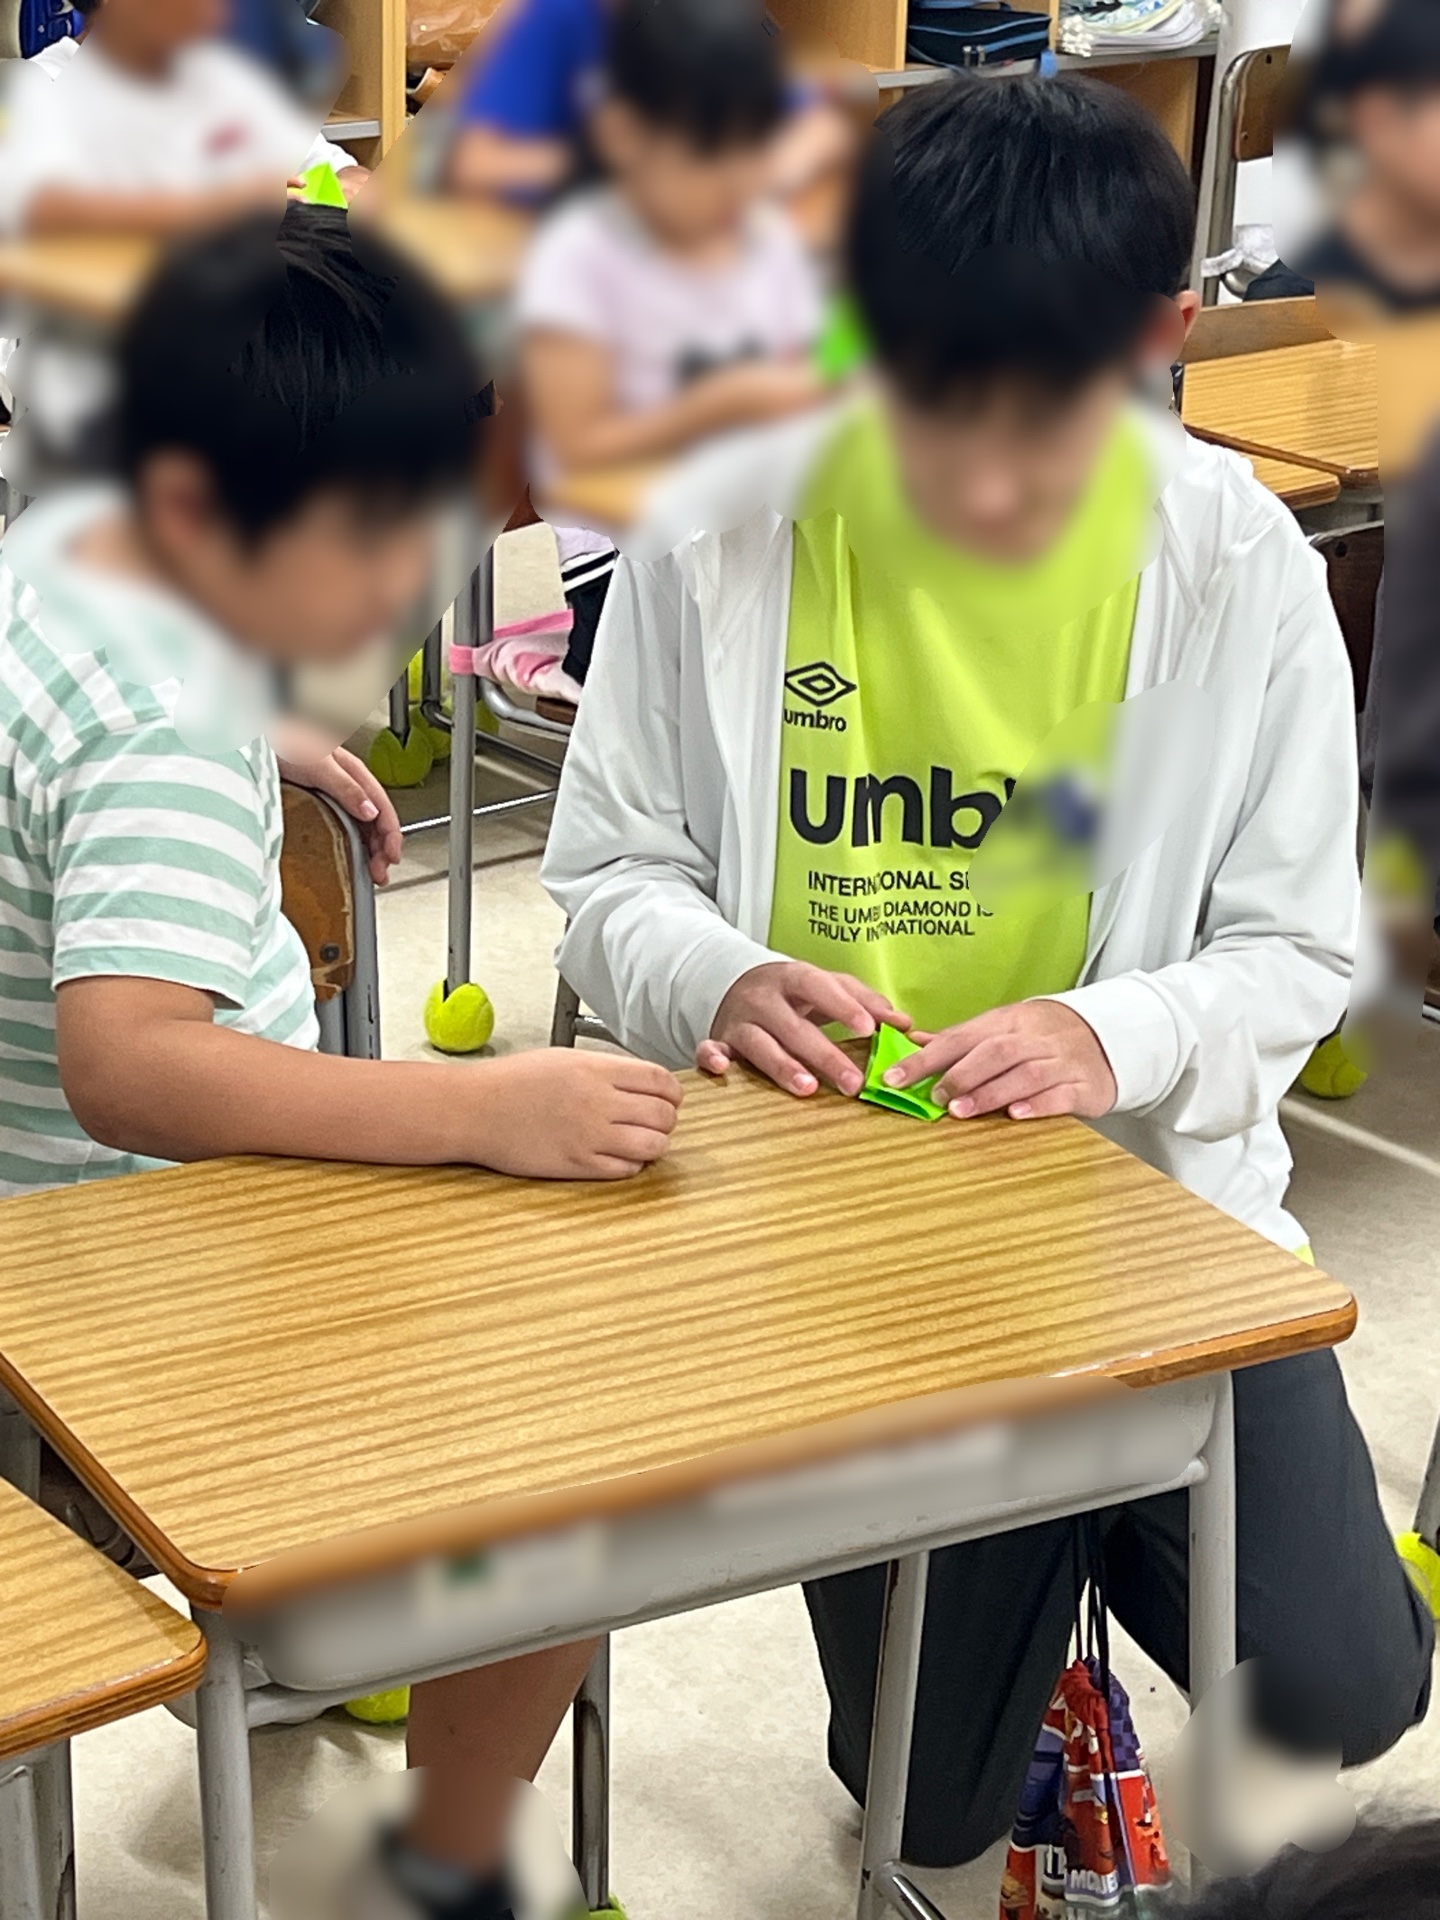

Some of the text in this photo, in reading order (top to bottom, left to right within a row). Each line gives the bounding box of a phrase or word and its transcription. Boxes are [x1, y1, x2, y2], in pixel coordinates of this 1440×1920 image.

[783, 709, 847, 732] umbro
[789, 765, 1016, 850] umb
[949, 870, 970, 891] S
[808, 900, 839, 922] THE
[844, 904, 881, 924] UMB
[883, 900, 971, 918] DIAMOND
[808, 919, 861, 943] TRULY
